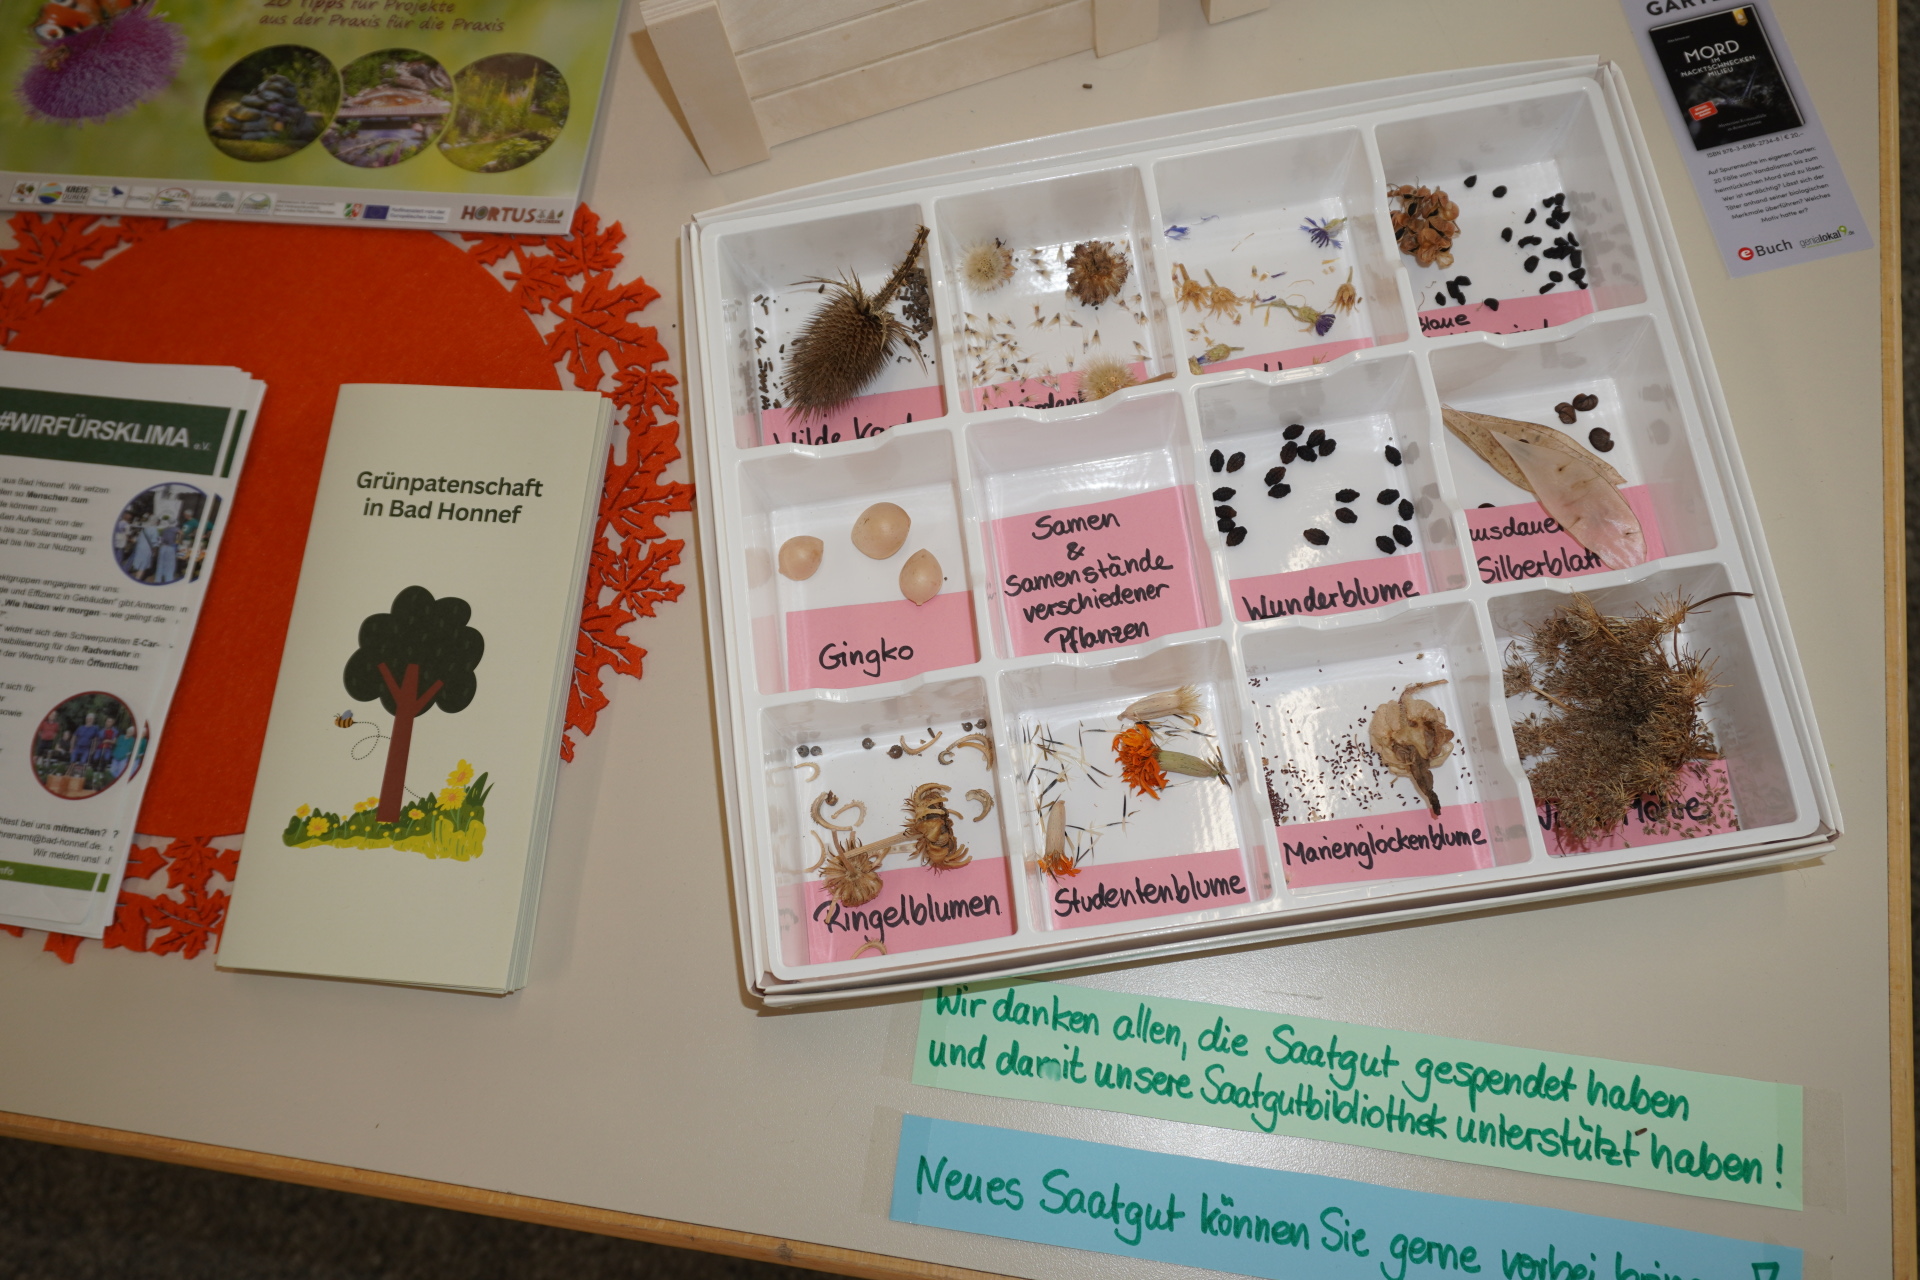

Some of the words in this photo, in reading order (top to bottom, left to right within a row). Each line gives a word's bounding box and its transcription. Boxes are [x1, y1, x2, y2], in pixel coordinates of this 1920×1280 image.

[383, 0, 456, 15] Projekte
[259, 14, 285, 25] aus
[293, 13, 322, 26] der
[328, 14, 380, 28] Praxis
[386, 15, 414, 30] für
[419, 15, 444, 30] die
[452, 18, 505, 32] Praxis
[1683, 40, 1740, 63] MORD
[1680, 55, 1756, 77] NACKTSCHNECKEN
[1707, 67, 1734, 77] MILIEU
[1708, 167, 1718, 176] Auf
[1720, 160, 1758, 174] Spurensuche
[1768, 152, 1792, 163] eigenen
[1793, 146, 1816, 156] Garten:
[1723, 174, 1738, 182] Fälle
[1739, 170, 1753, 178] vom
[1754, 161, 1793, 174] Vandalismus
[1714, 179, 1763, 194] heimtückischen
[1764, 173, 1781, 181] Mord
[1782, 170, 1796, 178] sind
[1805, 164, 1825, 173] lösen.
[1745, 184, 1781, 197] verdächtig?
[1783, 180, 1799, 188] Lässt
[1800, 176, 1812, 184] sich
[1731, 208, 1764, 220] Merkmale
[1765, 199, 1803, 213] überführen?
[1804, 192, 1831, 202] Welches
[1743, 197, 1768, 207] anhand
[1769, 193, 1788, 201] seiner
[1789, 182, 1829, 197] biologischen
[1761, 215, 1779, 223] Motiv
[1780, 210, 1797, 219] hatte
[1798, 207, 1808, 215] er?
[1755, 240, 1793, 256] Buch
[0, 410, 190, 448] #WIRFÜRSKLIMA
[18, 477, 33, 485] Bad
[68, 482, 81, 490] Wir
[83, 485, 109, 493] setzen
[26, 490, 69, 501] Menschen
[356, 471, 543, 497] Grünpatenschaft
[9, 501, 38, 511] können
[363, 498, 383, 516] in
[389, 499, 433, 519] Bad
[437, 502, 523, 523] Honnef
[32, 528, 78, 540] Solaranlage
[71, 519, 84, 527] der
[1031, 511, 1120, 540] Samen
[1067, 541, 1086, 560] &
[43, 578, 87, 590] engagieren
[1004, 548, 1174, 597] Samenstände
[10, 587, 26, 595] und
[27, 588, 61, 600] Effizienz
[62, 592, 70, 600] in
[118, 598, 134, 608] gibt
[134, 599, 175, 611] Antworten
[1023, 582, 1170, 623] verschiedener
[1241, 577, 1420, 621] Wunderblume
[22, 600, 50, 611] heizen
[52, 604, 66, 612] wir
[67, 606, 100, 617] morgen
[109, 610, 122, 618] wie
[125, 612, 151, 623] gelingt
[152, 614, 166, 623] die
[4, 625, 32, 634] widmet
[34, 627, 50, 636] sich
[52, 630, 68, 638] den
[69, 630, 131, 646] Schwerpunkten
[1043, 619, 1150, 654] Pflanzen
[3, 648, 16, 657] der
[18, 650, 55, 663] Werbung
[56, 654, 68, 662] für
[69, 656, 85, 665] den
[86, 656, 139, 671] Öffentlichen
[52, 642, 63, 650] für
[64, 643, 80, 652] den
[81, 644, 131, 657] Radverkehr
[132, 650, 140, 658] in
[818, 636, 915, 678] Gingko
[5, 682, 23, 691] sich
[24, 683, 36, 693] für
[20, 819, 34, 827] bei
[53, 824, 107, 837] mitmachen?
[33, 848, 48, 857] Wir
[49, 850, 79, 861] melden
[81, 856, 101, 864] uns!
[1053, 871, 1247, 918] Studentenblume
[812, 892, 1002, 942] Ringelblumen
[935, 984, 987, 1018] Wir
[992, 987, 1099, 1035] danken
[1113, 1002, 1188, 1061] allen,
[1198, 1016, 1250, 1056] die
[1265, 1023, 1400, 1091] Saatgut
[1401, 1057, 1577, 1113] gespendet
[1587, 1068, 1690, 1122] haben
[929, 1034, 988, 1071] und
[995, 1041, 1087, 1085] damit
[1095, 1061, 1193, 1100] unsere
[1200, 1063, 1448, 1134] Saatgutbibliothek
[1456, 1113, 1641, 1168] unterstützt
[916, 1154, 1025, 1211] Neues
[1039, 1168, 1186, 1248] Saatgut
[1201, 1192, 1310, 1251] können
[1319, 1206, 1370, 1257] Sie
[1379, 1232, 1482, 1280] gerne
